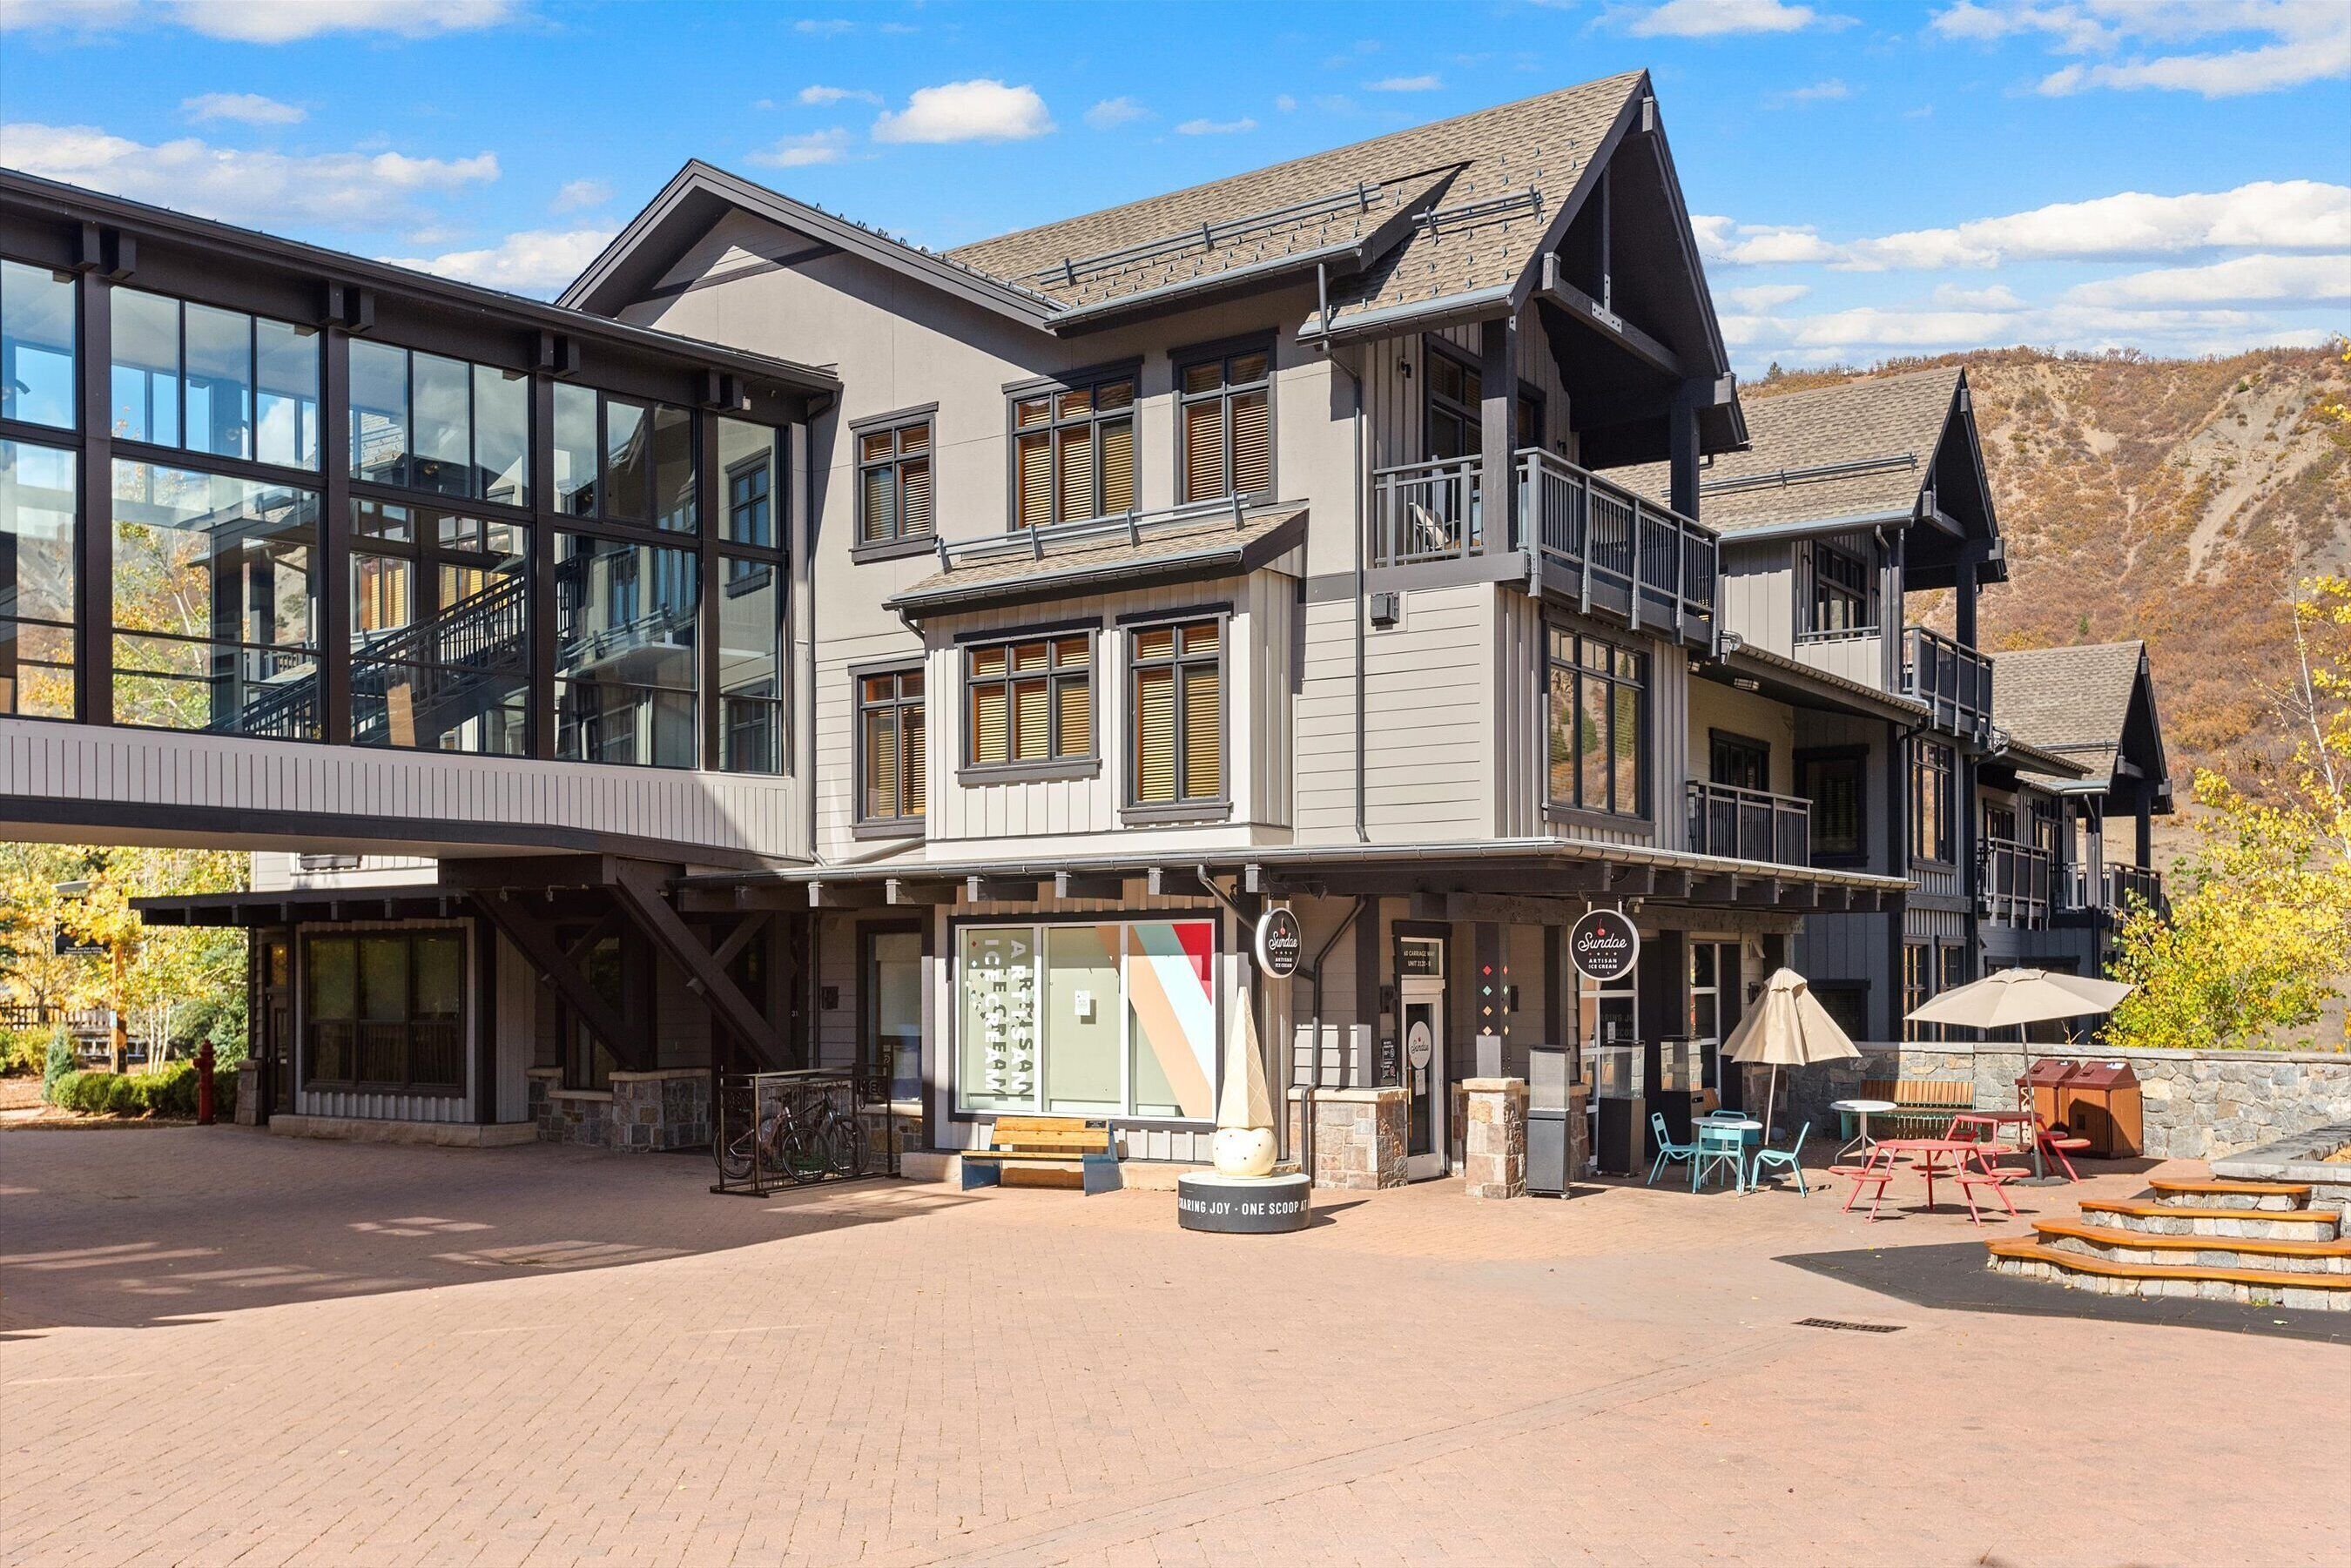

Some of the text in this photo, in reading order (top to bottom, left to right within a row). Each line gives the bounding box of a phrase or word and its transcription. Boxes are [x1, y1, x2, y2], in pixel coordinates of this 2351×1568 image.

[1269, 931, 1297, 950] Sundae
[1577, 932, 1627, 952] Sundae
[985, 939, 1000, 1090] ICE CREAM
[1011, 940, 1027, 1090] ARTISAN
[1209, 1202, 1231, 1215] JOY
[1242, 1202, 1265, 1215] ONE
[1269, 1201, 1299, 1215] SCOOP
[1300, 1199, 1307, 1212] AT
